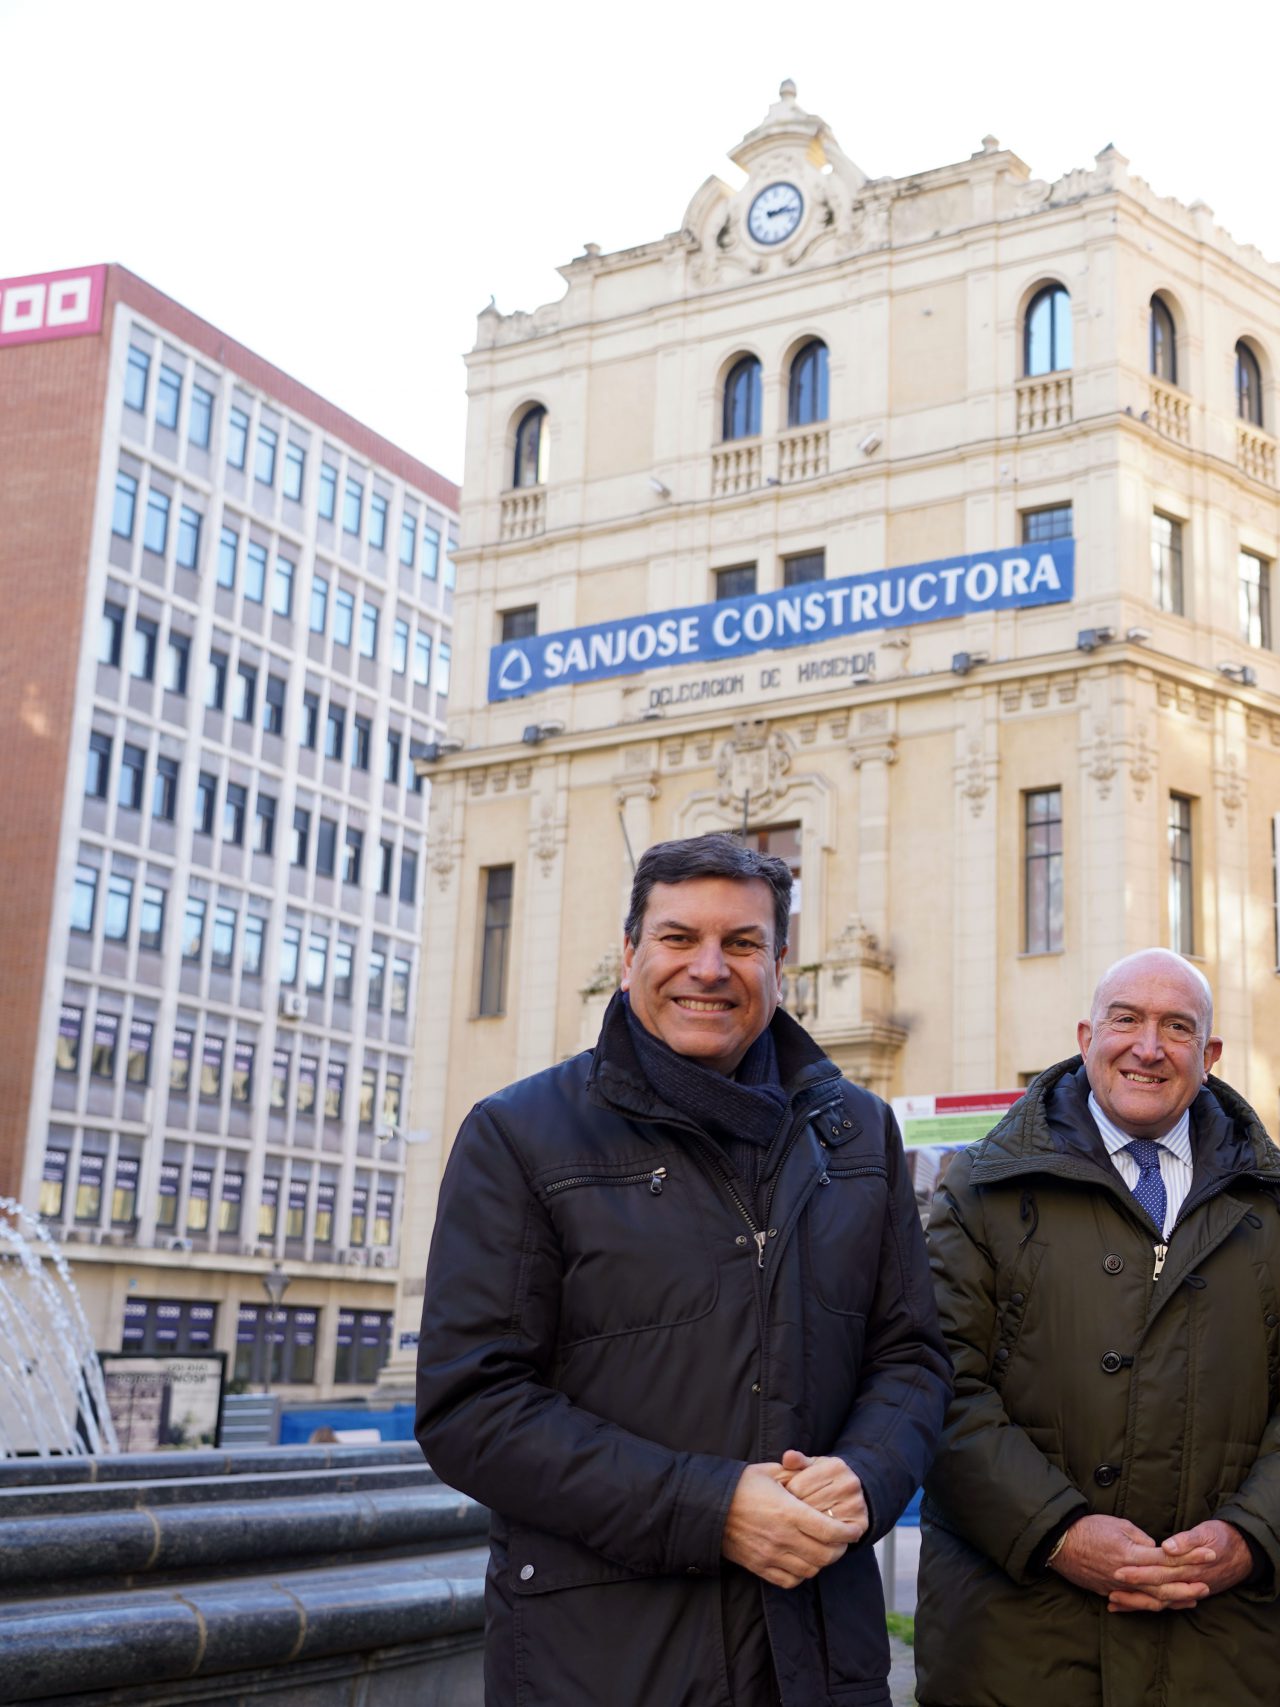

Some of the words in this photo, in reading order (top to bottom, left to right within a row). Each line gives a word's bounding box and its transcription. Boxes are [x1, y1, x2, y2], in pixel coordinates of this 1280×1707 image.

[543, 616, 699, 679] SANJOSE
[712, 553, 1061, 647] CONSTRUCTORA
[760, 668, 781, 690] DE
